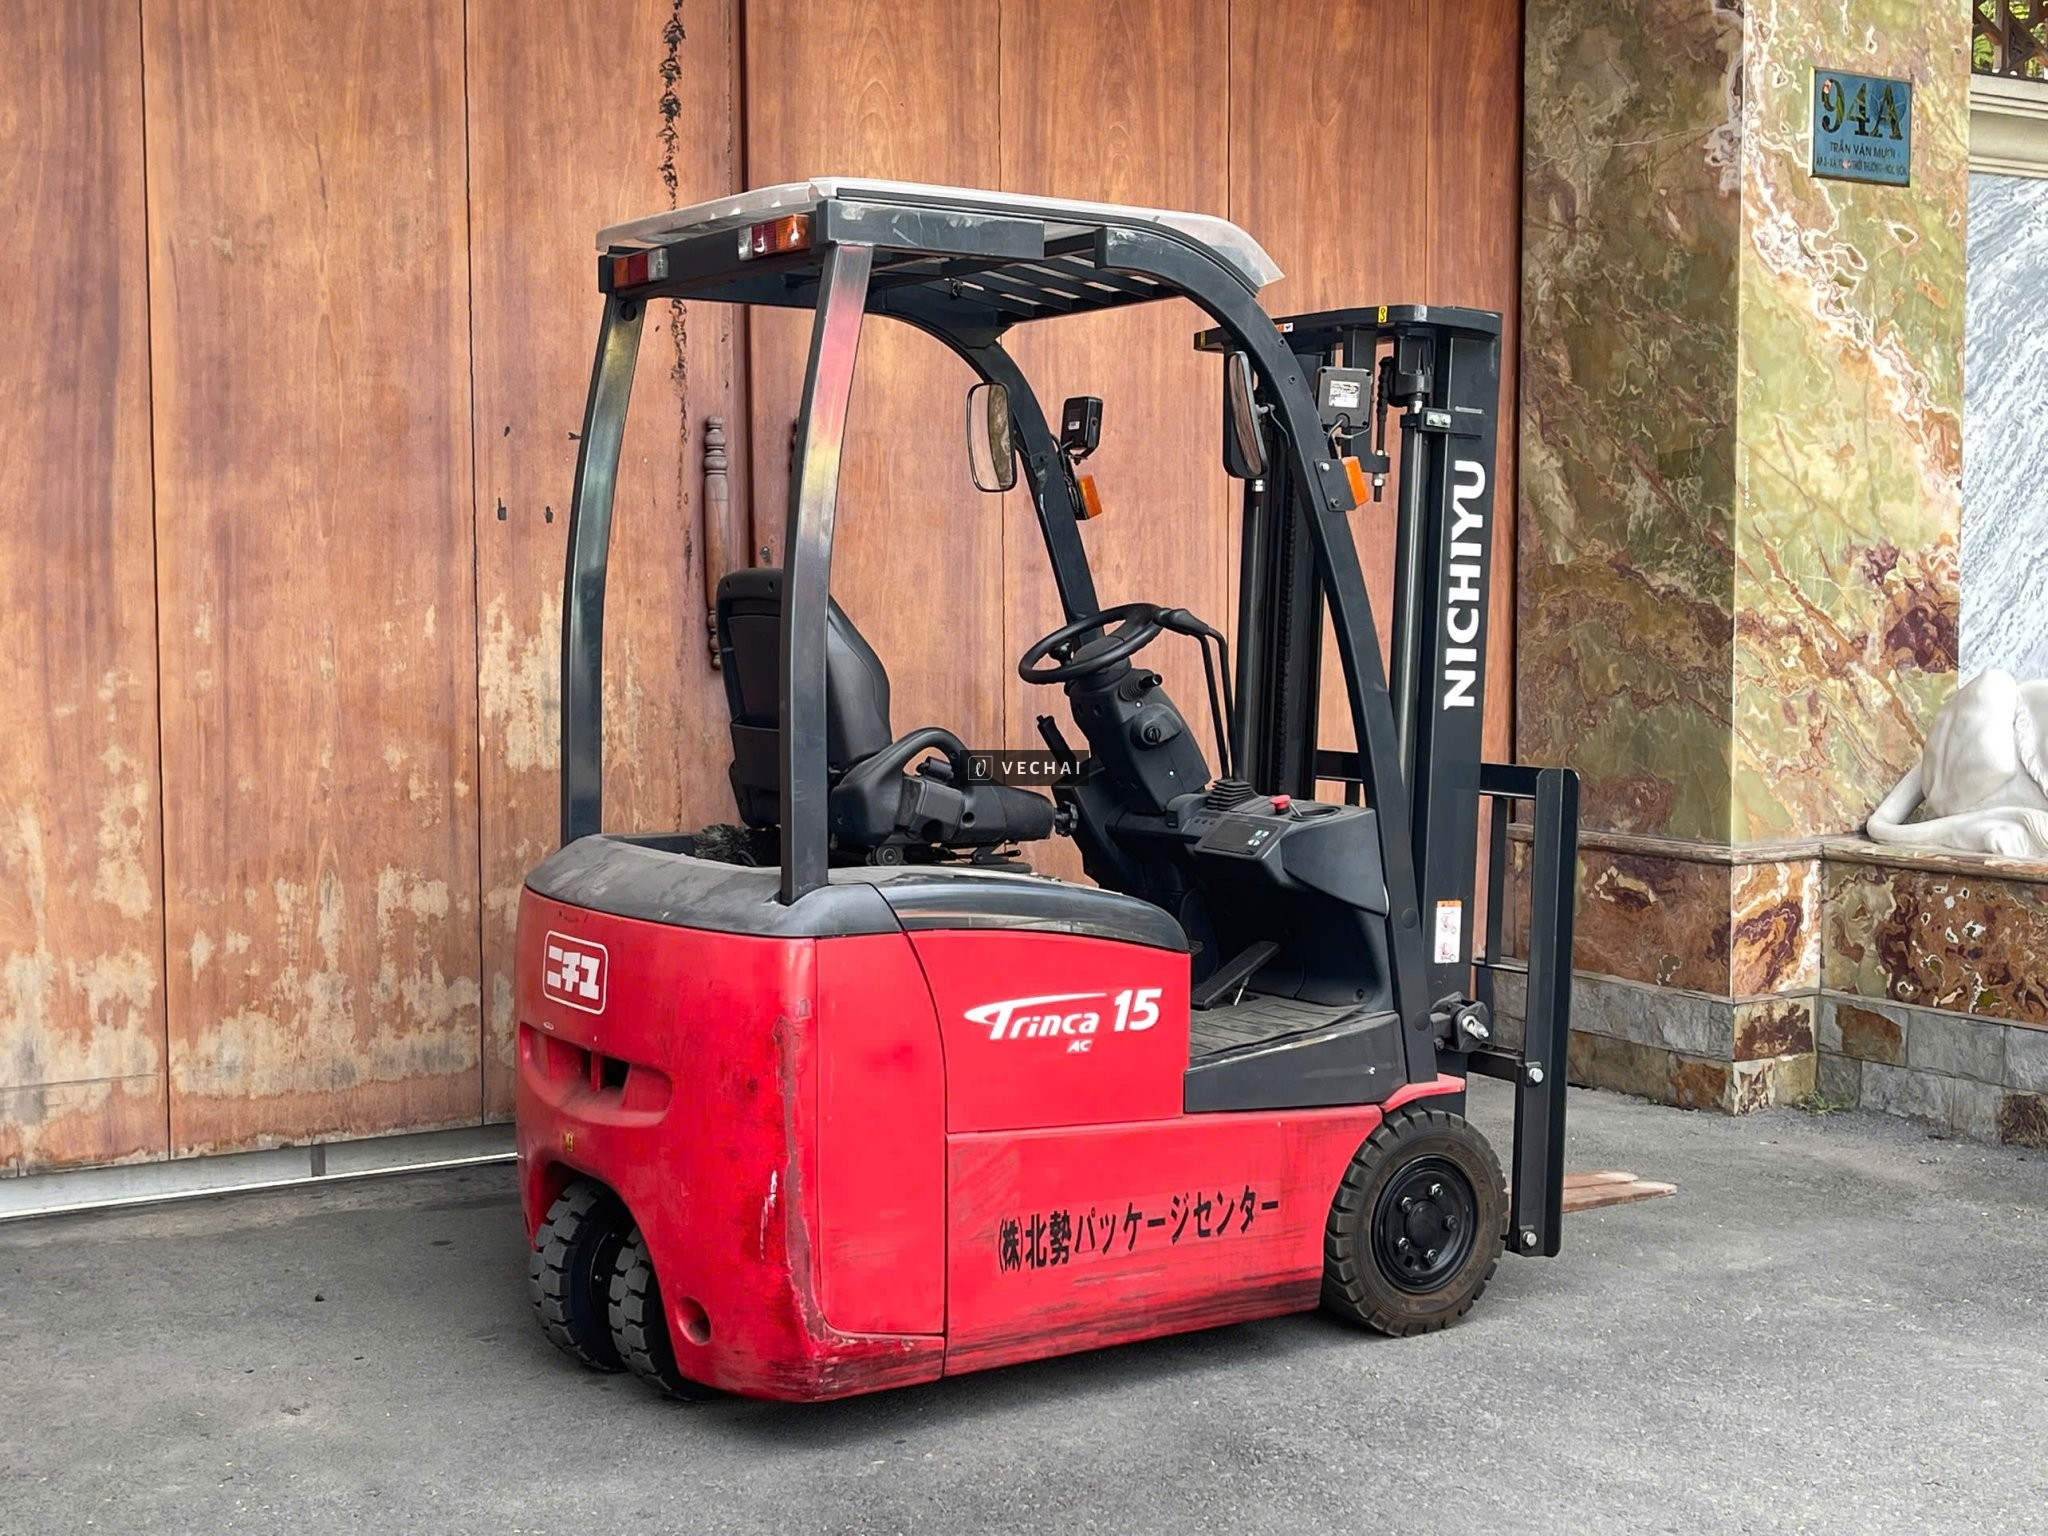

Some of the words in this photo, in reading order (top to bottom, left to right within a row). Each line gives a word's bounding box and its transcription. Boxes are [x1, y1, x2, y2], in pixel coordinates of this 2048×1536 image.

[1821, 78, 1903, 140] 94A
[1443, 459, 1486, 711] NICHIYU
[964, 992, 1107, 1040] Trinca
[1114, 988, 1162, 1032] 15
[1066, 1039, 1093, 1053] AC
